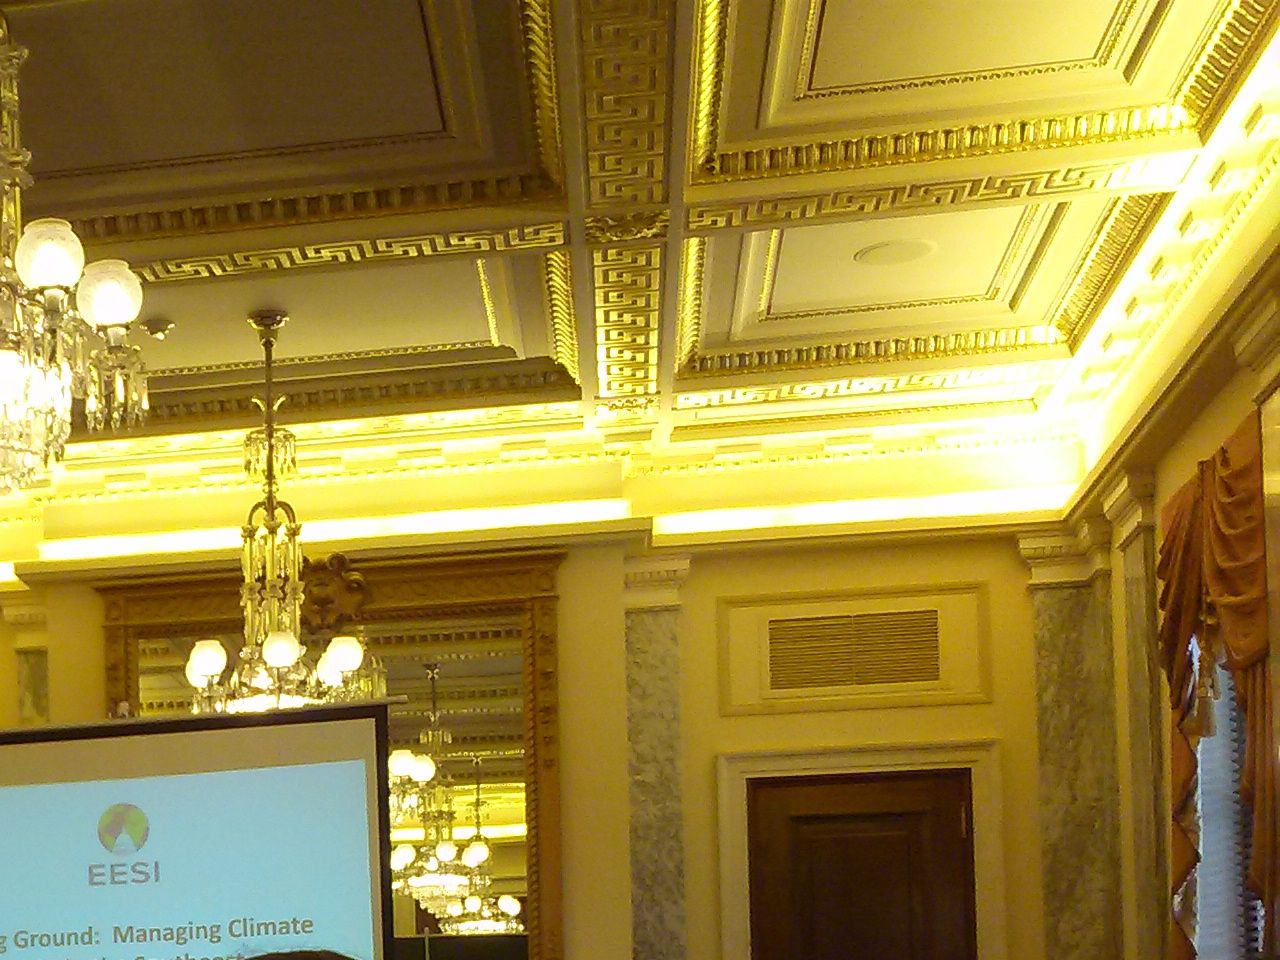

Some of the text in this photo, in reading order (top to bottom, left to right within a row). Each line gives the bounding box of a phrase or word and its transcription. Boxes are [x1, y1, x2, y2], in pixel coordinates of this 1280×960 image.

[88, 861, 159, 886] EESI
[13, 926, 101, 949] Ground:
[113, 921, 222, 945] Managing
[228, 917, 314, 938] Climate
